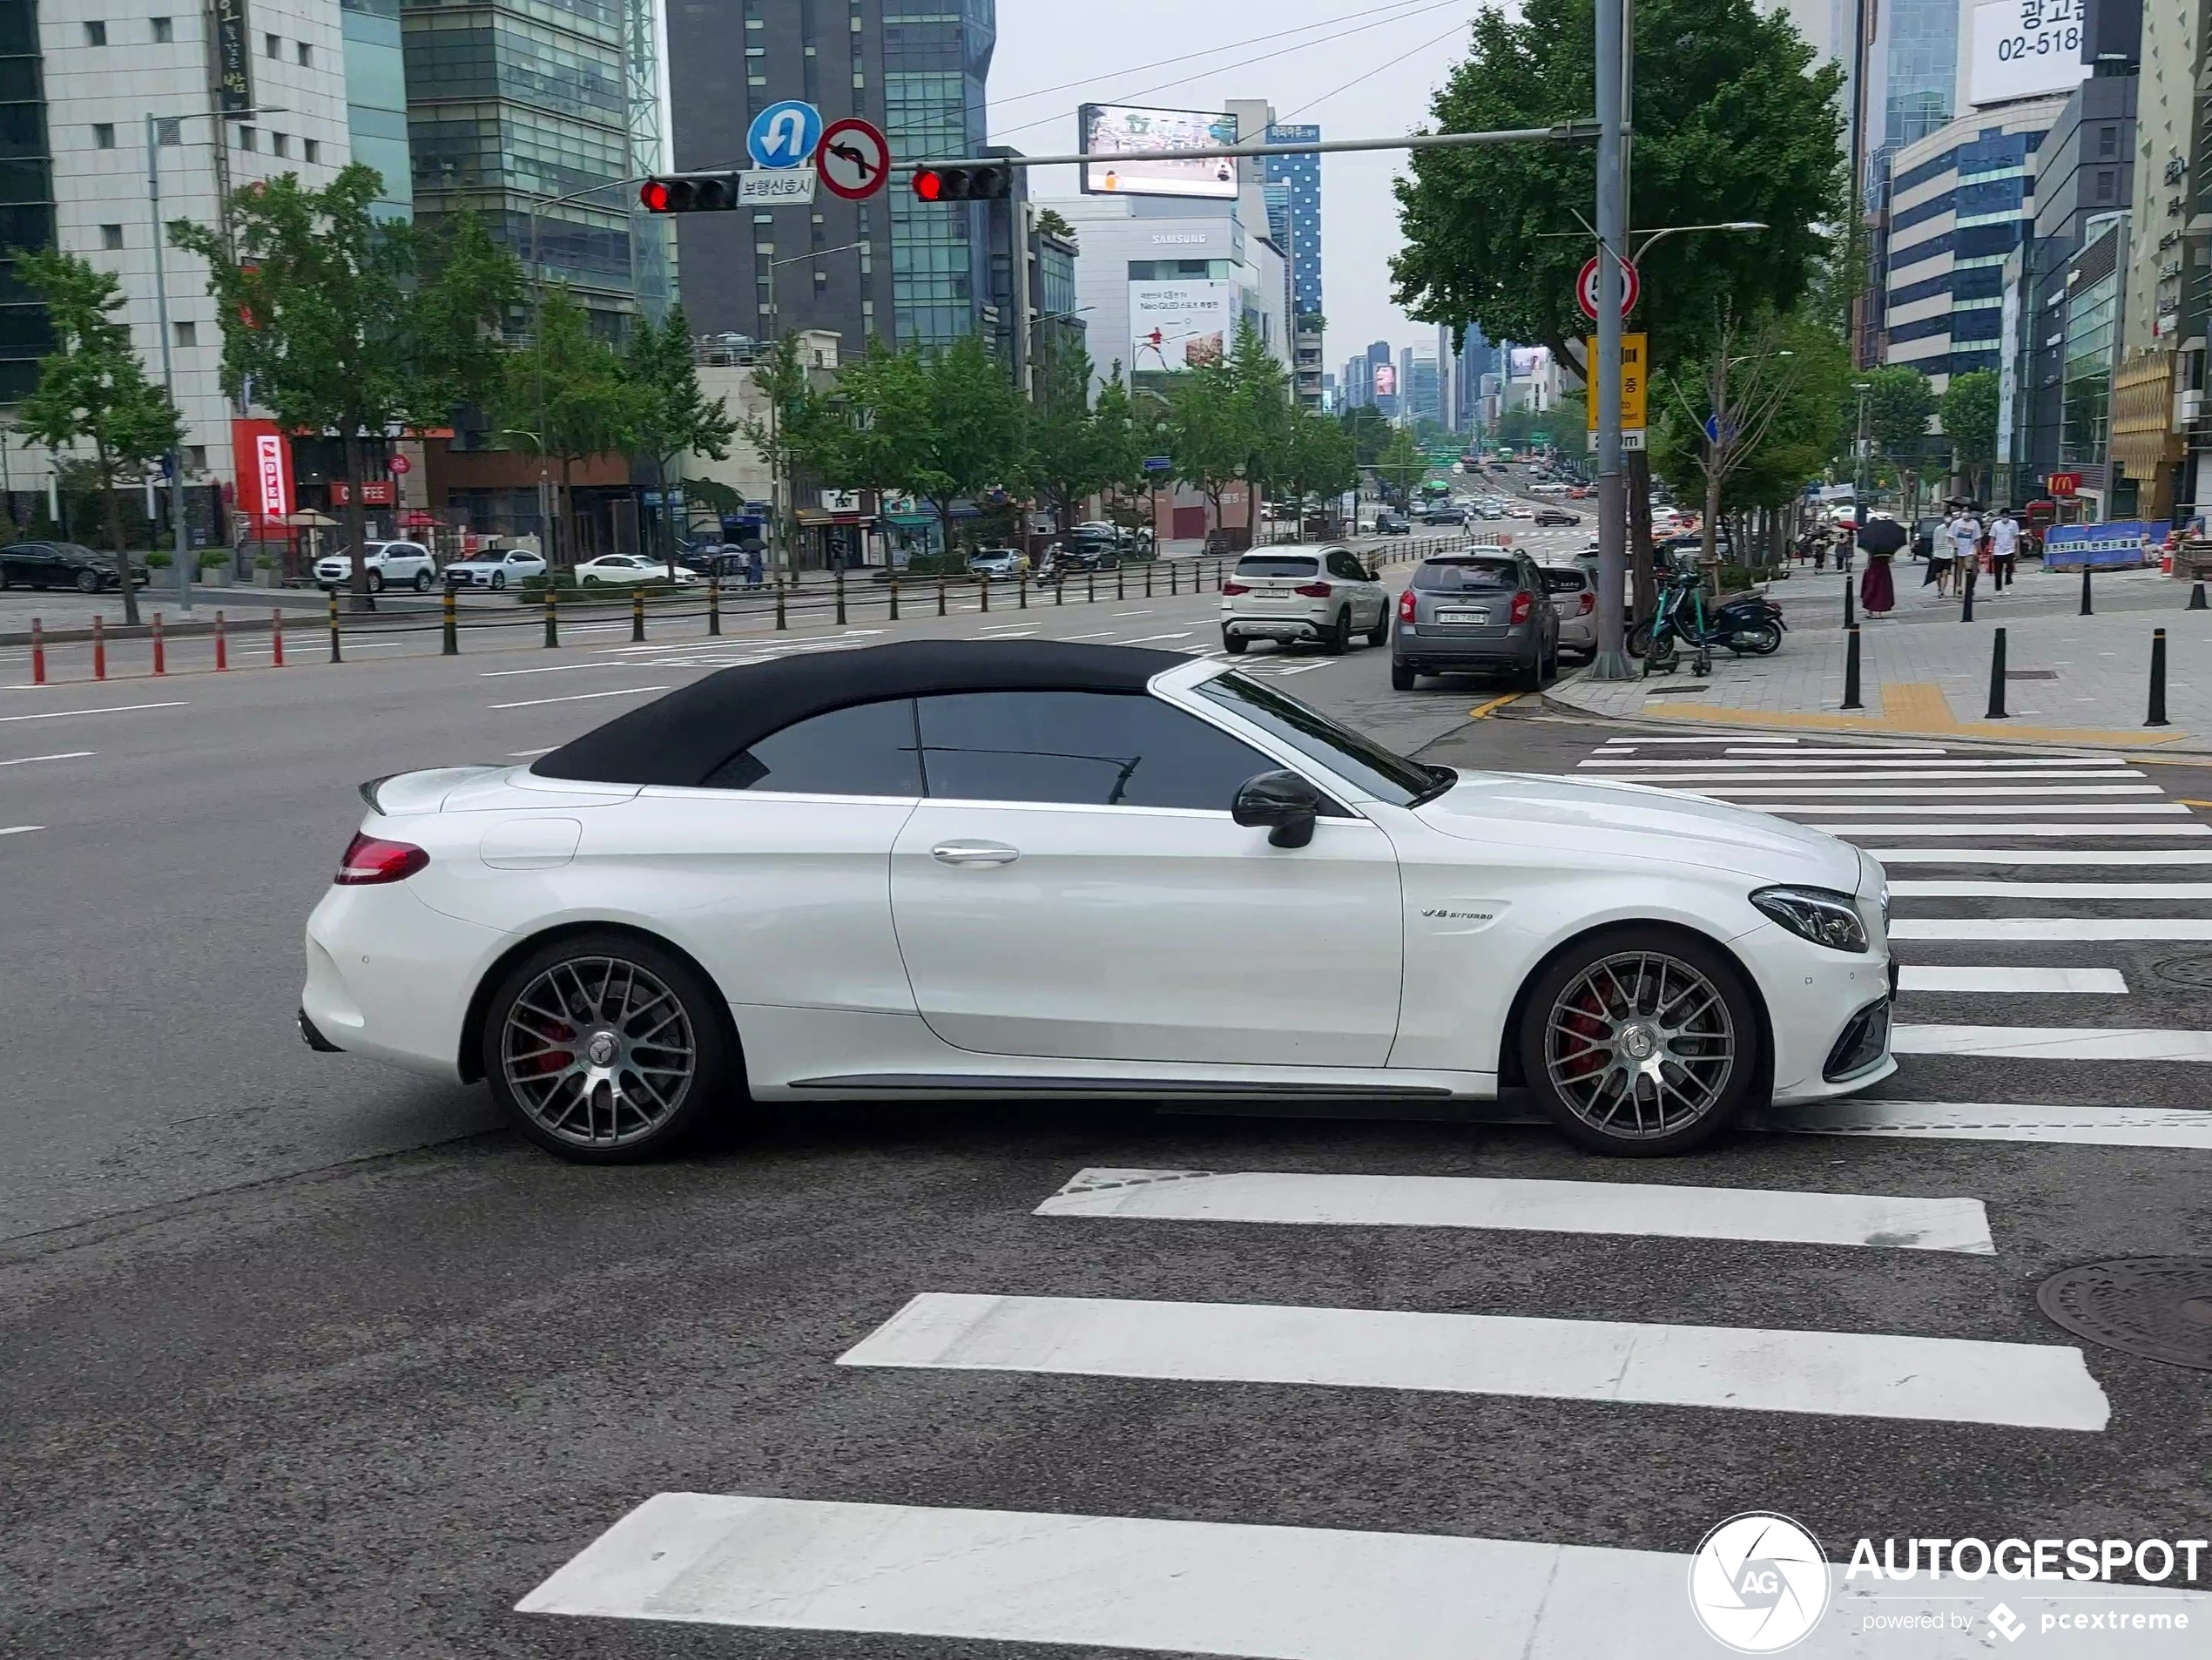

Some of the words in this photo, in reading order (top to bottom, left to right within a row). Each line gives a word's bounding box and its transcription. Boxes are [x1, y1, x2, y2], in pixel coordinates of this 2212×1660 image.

[742, 178, 812, 197] 보행신호시
[1152, 233, 1207, 245] SAMSUNG
[1421, 908, 1447, 917] V8
[1449, 911, 1493, 920] BITURBO
